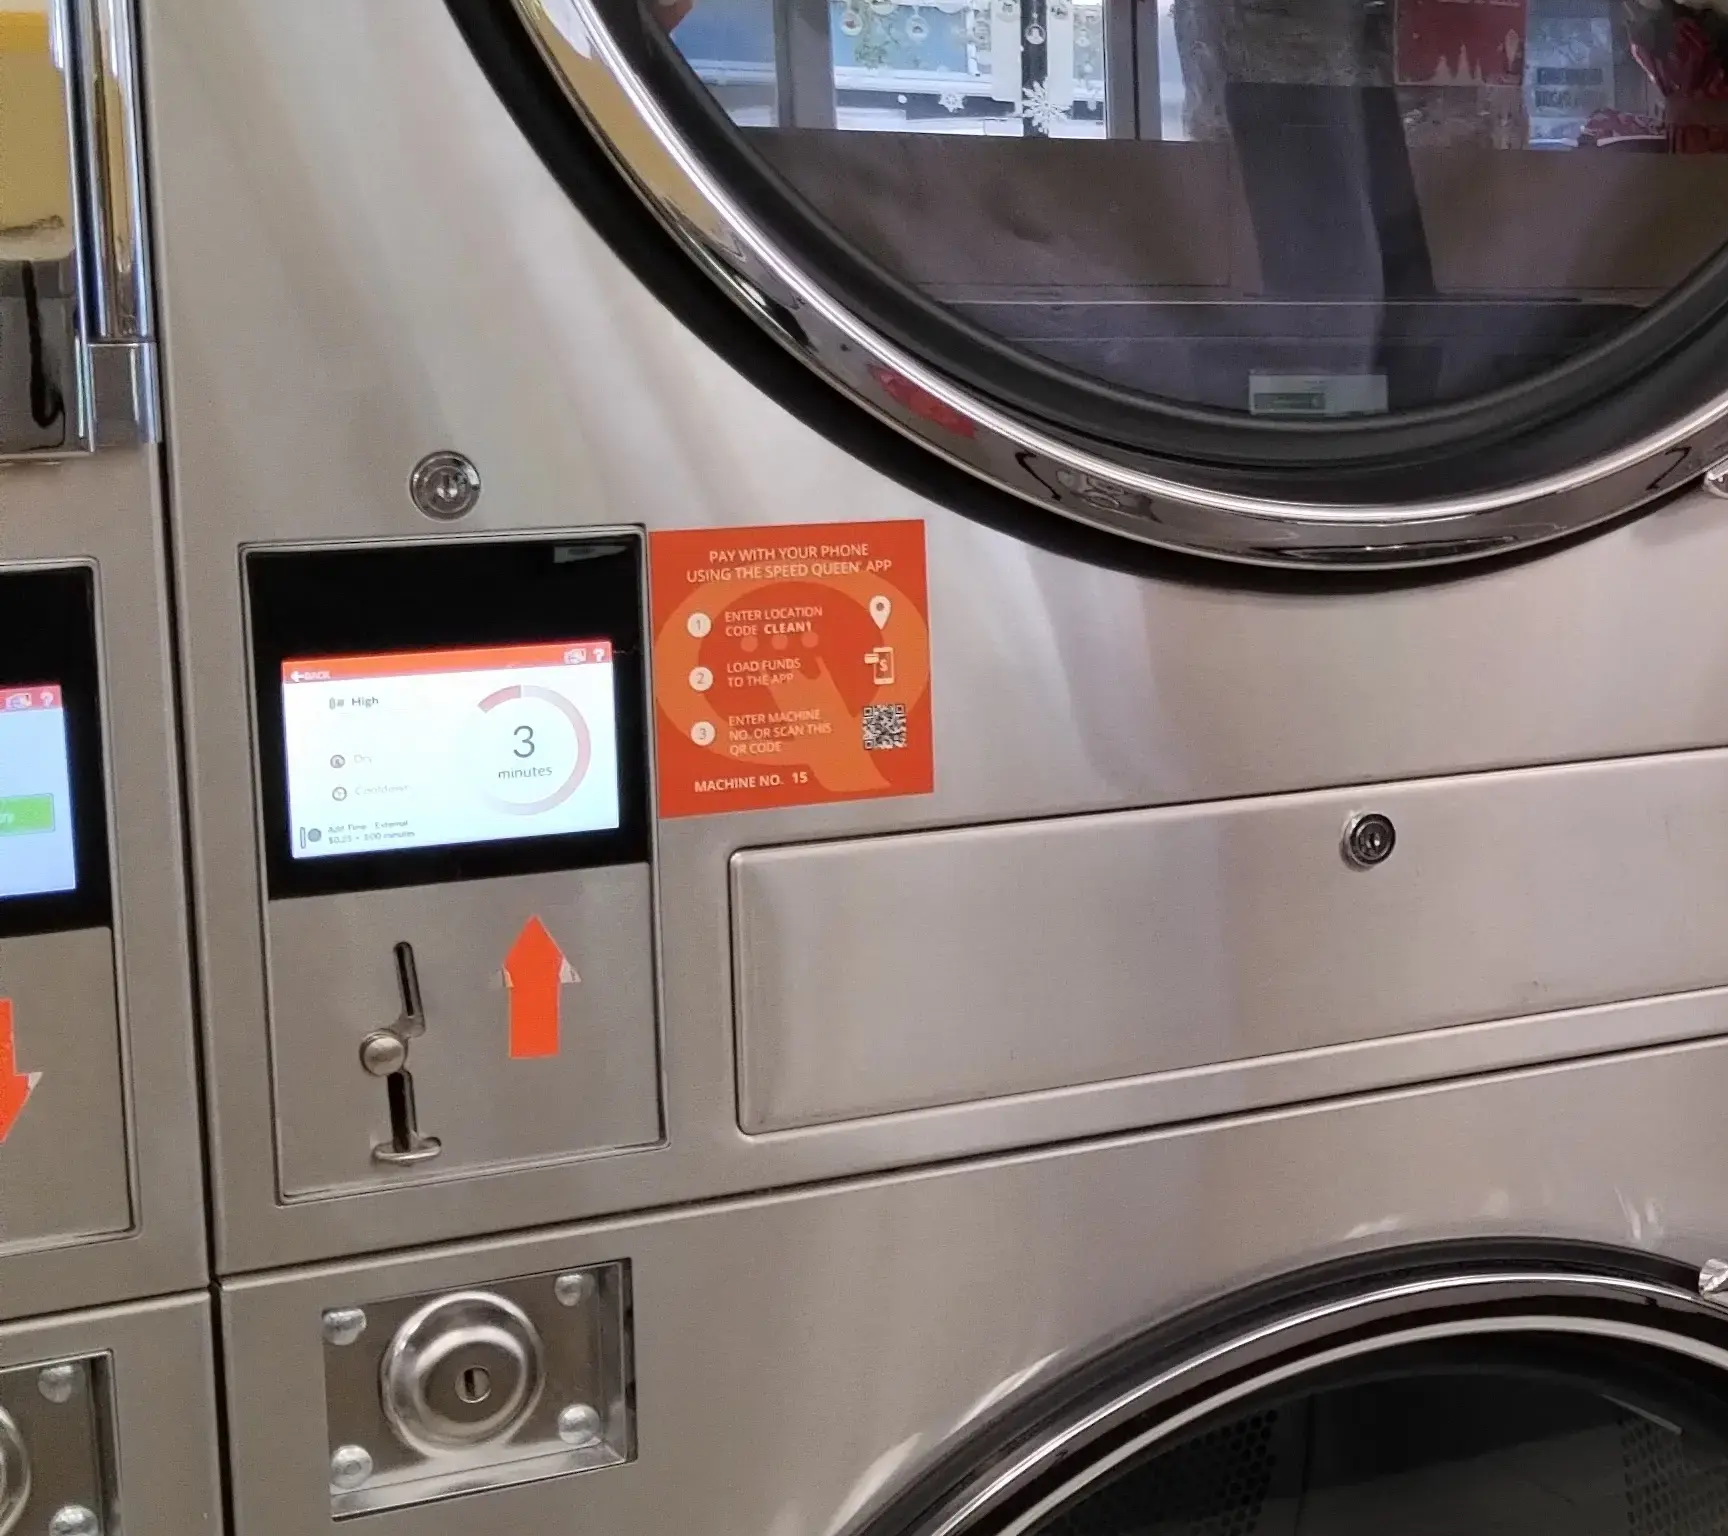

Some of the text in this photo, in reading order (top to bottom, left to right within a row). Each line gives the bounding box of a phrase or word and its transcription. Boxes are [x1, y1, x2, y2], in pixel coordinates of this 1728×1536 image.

[709, 543, 869, 564] PAY WITH YOUR PHONE
[686, 567, 732, 583] USING
[734, 565, 761, 580] THE
[765, 563, 809, 579] SPEED
[866, 559, 892, 572] APP
[724, 606, 823, 623] ENTER LOCATION
[725, 621, 812, 637] CODE CLEAN1
[726, 658, 801, 674] LOAD FUNDS
[727, 672, 794, 688] TO THE APP
[351, 696, 379, 708] High
[728, 709, 821, 727] ENTER MACHINE
[729, 722, 832, 742] NO. OR SCAN THIS
[512, 724, 537, 760] 3
[729, 740, 783, 757] QR CODE
[497, 764, 553, 781] minutes
[694, 771, 808, 793] MACHINE NO. 15
